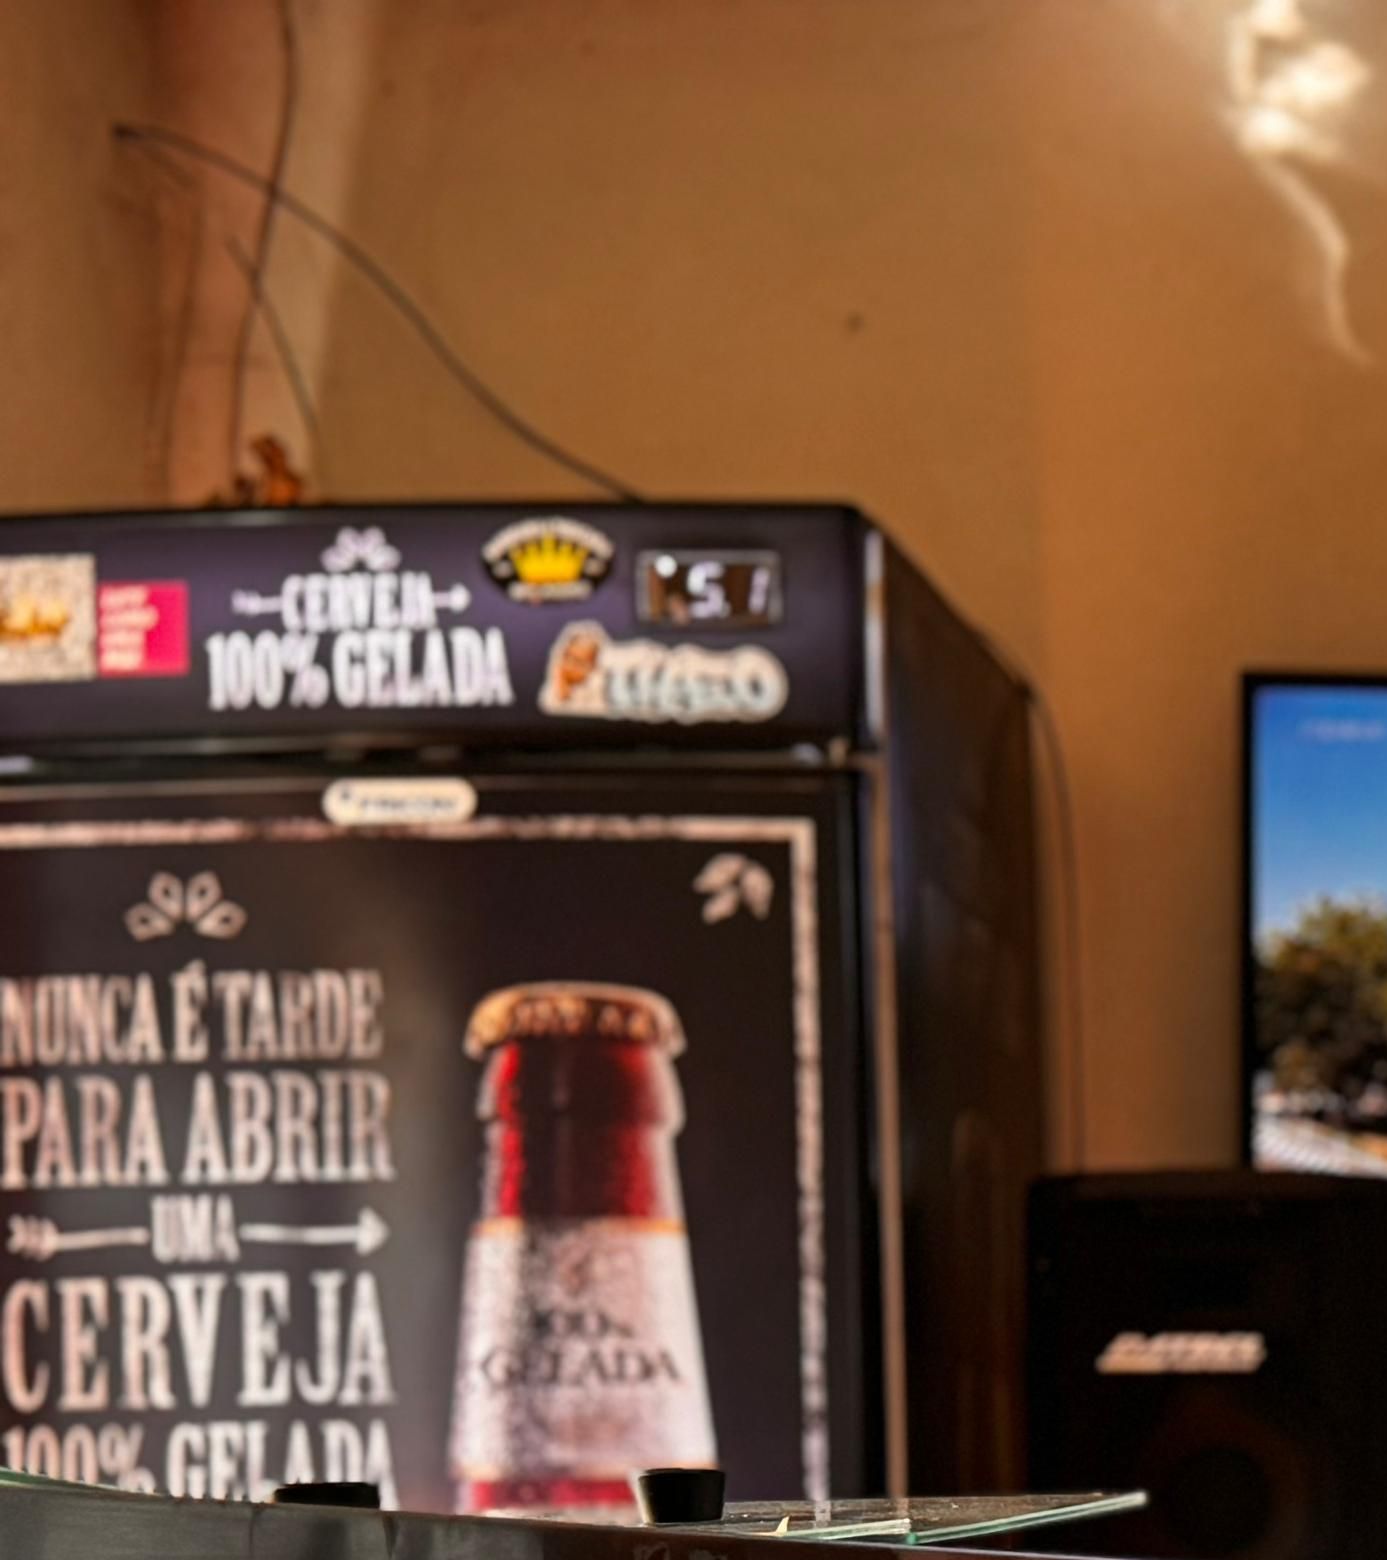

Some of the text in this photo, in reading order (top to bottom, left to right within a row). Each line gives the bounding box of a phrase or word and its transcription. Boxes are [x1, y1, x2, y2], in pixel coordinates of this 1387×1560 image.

[281, 572, 437, 631] CERVEJA
[206, 629, 329, 709] 100%
[333, 626, 514, 708] GELADA
[0, 972, 163, 1067] NUNCA
[171, 958, 209, 1063] É
[213, 968, 385, 1061] TARDE
[0, 1069, 397, 1190] PARA ABRIR
[151, 1194, 240, 1262] UMA
[2, 1270, 396, 1413] CERVEJA
